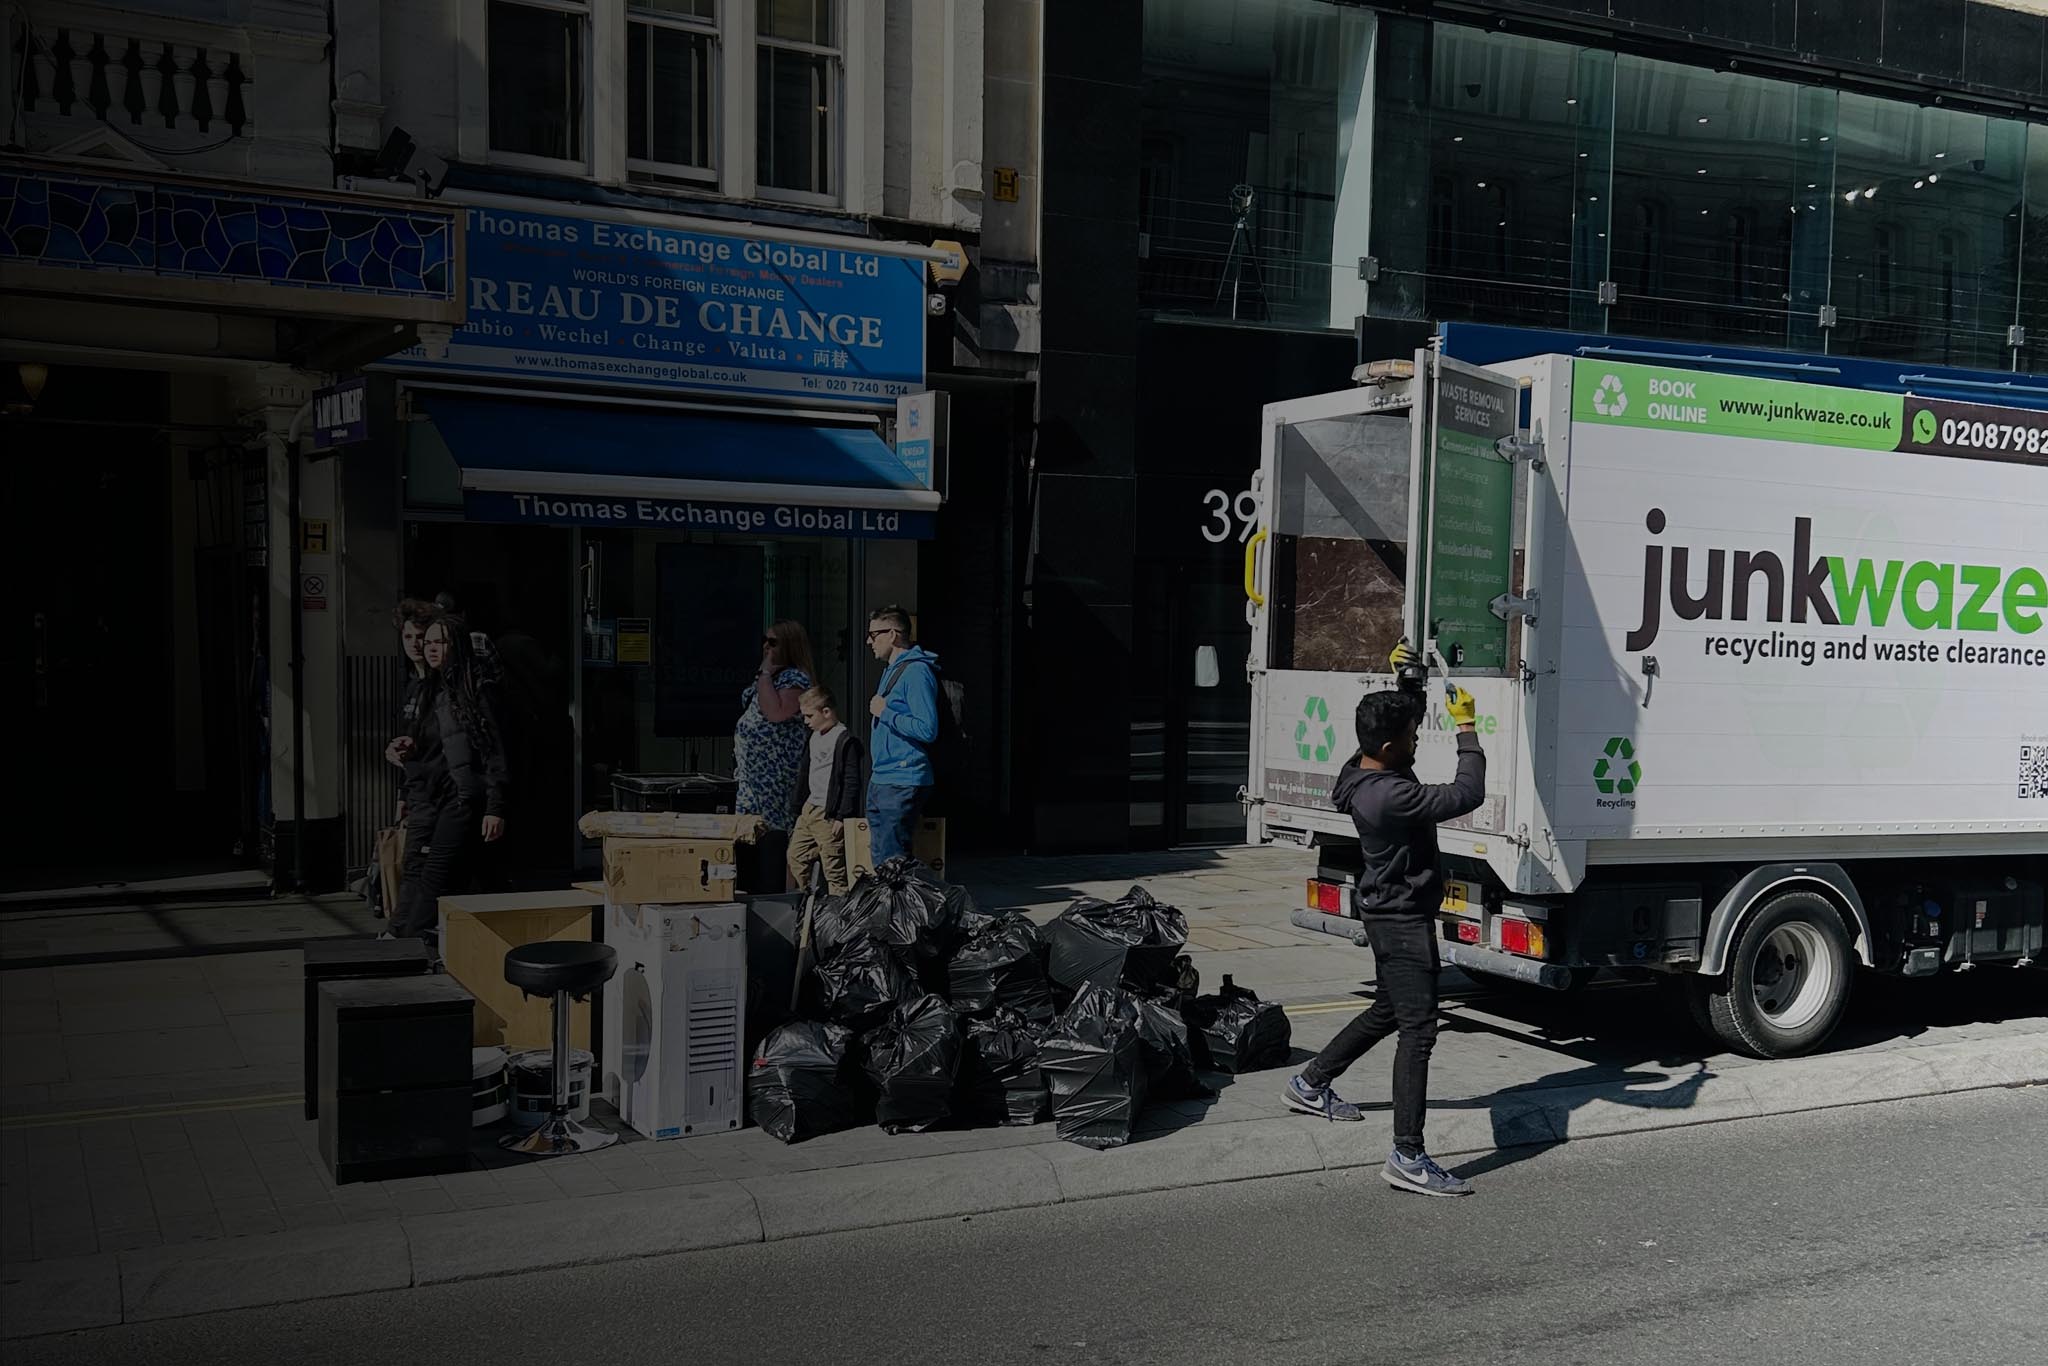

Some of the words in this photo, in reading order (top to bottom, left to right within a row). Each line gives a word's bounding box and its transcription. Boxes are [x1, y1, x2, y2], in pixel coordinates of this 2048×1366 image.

[464, 208, 579, 243] Thomas
[593, 223, 731, 264] Exchange
[743, 240, 828, 272] Global
[840, 252, 879, 278] Ltd
[572, 268, 640, 287] WORLD'S
[644, 275, 706, 294] FOREIGN
[711, 282, 784, 302] EXCHANGE
[620, 292, 681, 329] DE
[698, 301, 884, 349] CHANGE
[455, 319, 514, 337] mbio
[538, 323, 609, 346] Wechel
[633, 332, 706, 357] Change
[728, 341, 787, 361] Valuta
[514, 353, 747, 384] www.thomasexchangeglobal.co.uk
[812, 349, 848, 369] 両替
[801, 377, 821, 390] Tel:
[826, 379, 847, 391] 020
[851, 381, 879, 394] 7240
[884, 383, 908, 396] 1214
[1441, 381, 1468, 404] WASTE
[1470, 390, 1505, 414] REMOVAL
[1648, 378, 1696, 400] BOOK
[1454, 405, 1491, 428] SERVICES
[1647, 402, 1707, 425] ONLINE
[1719, 397, 1892, 430] www.junkwaze.co.uk
[513, 493, 627, 521] Thomas
[637, 500, 766, 531] Exchange
[774, 507, 852, 530] Global
[861, 509, 900, 532] Ltd
[1626, 508, 2048, 651] junkwaze
[1704, 631, 1815, 666] recycling
[1823, 635, 1868, 661] and
[1873, 639, 1940, 664] waste
[1946, 639, 2046, 667] clearance
[1596, 797, 1636, 811] Recycling
